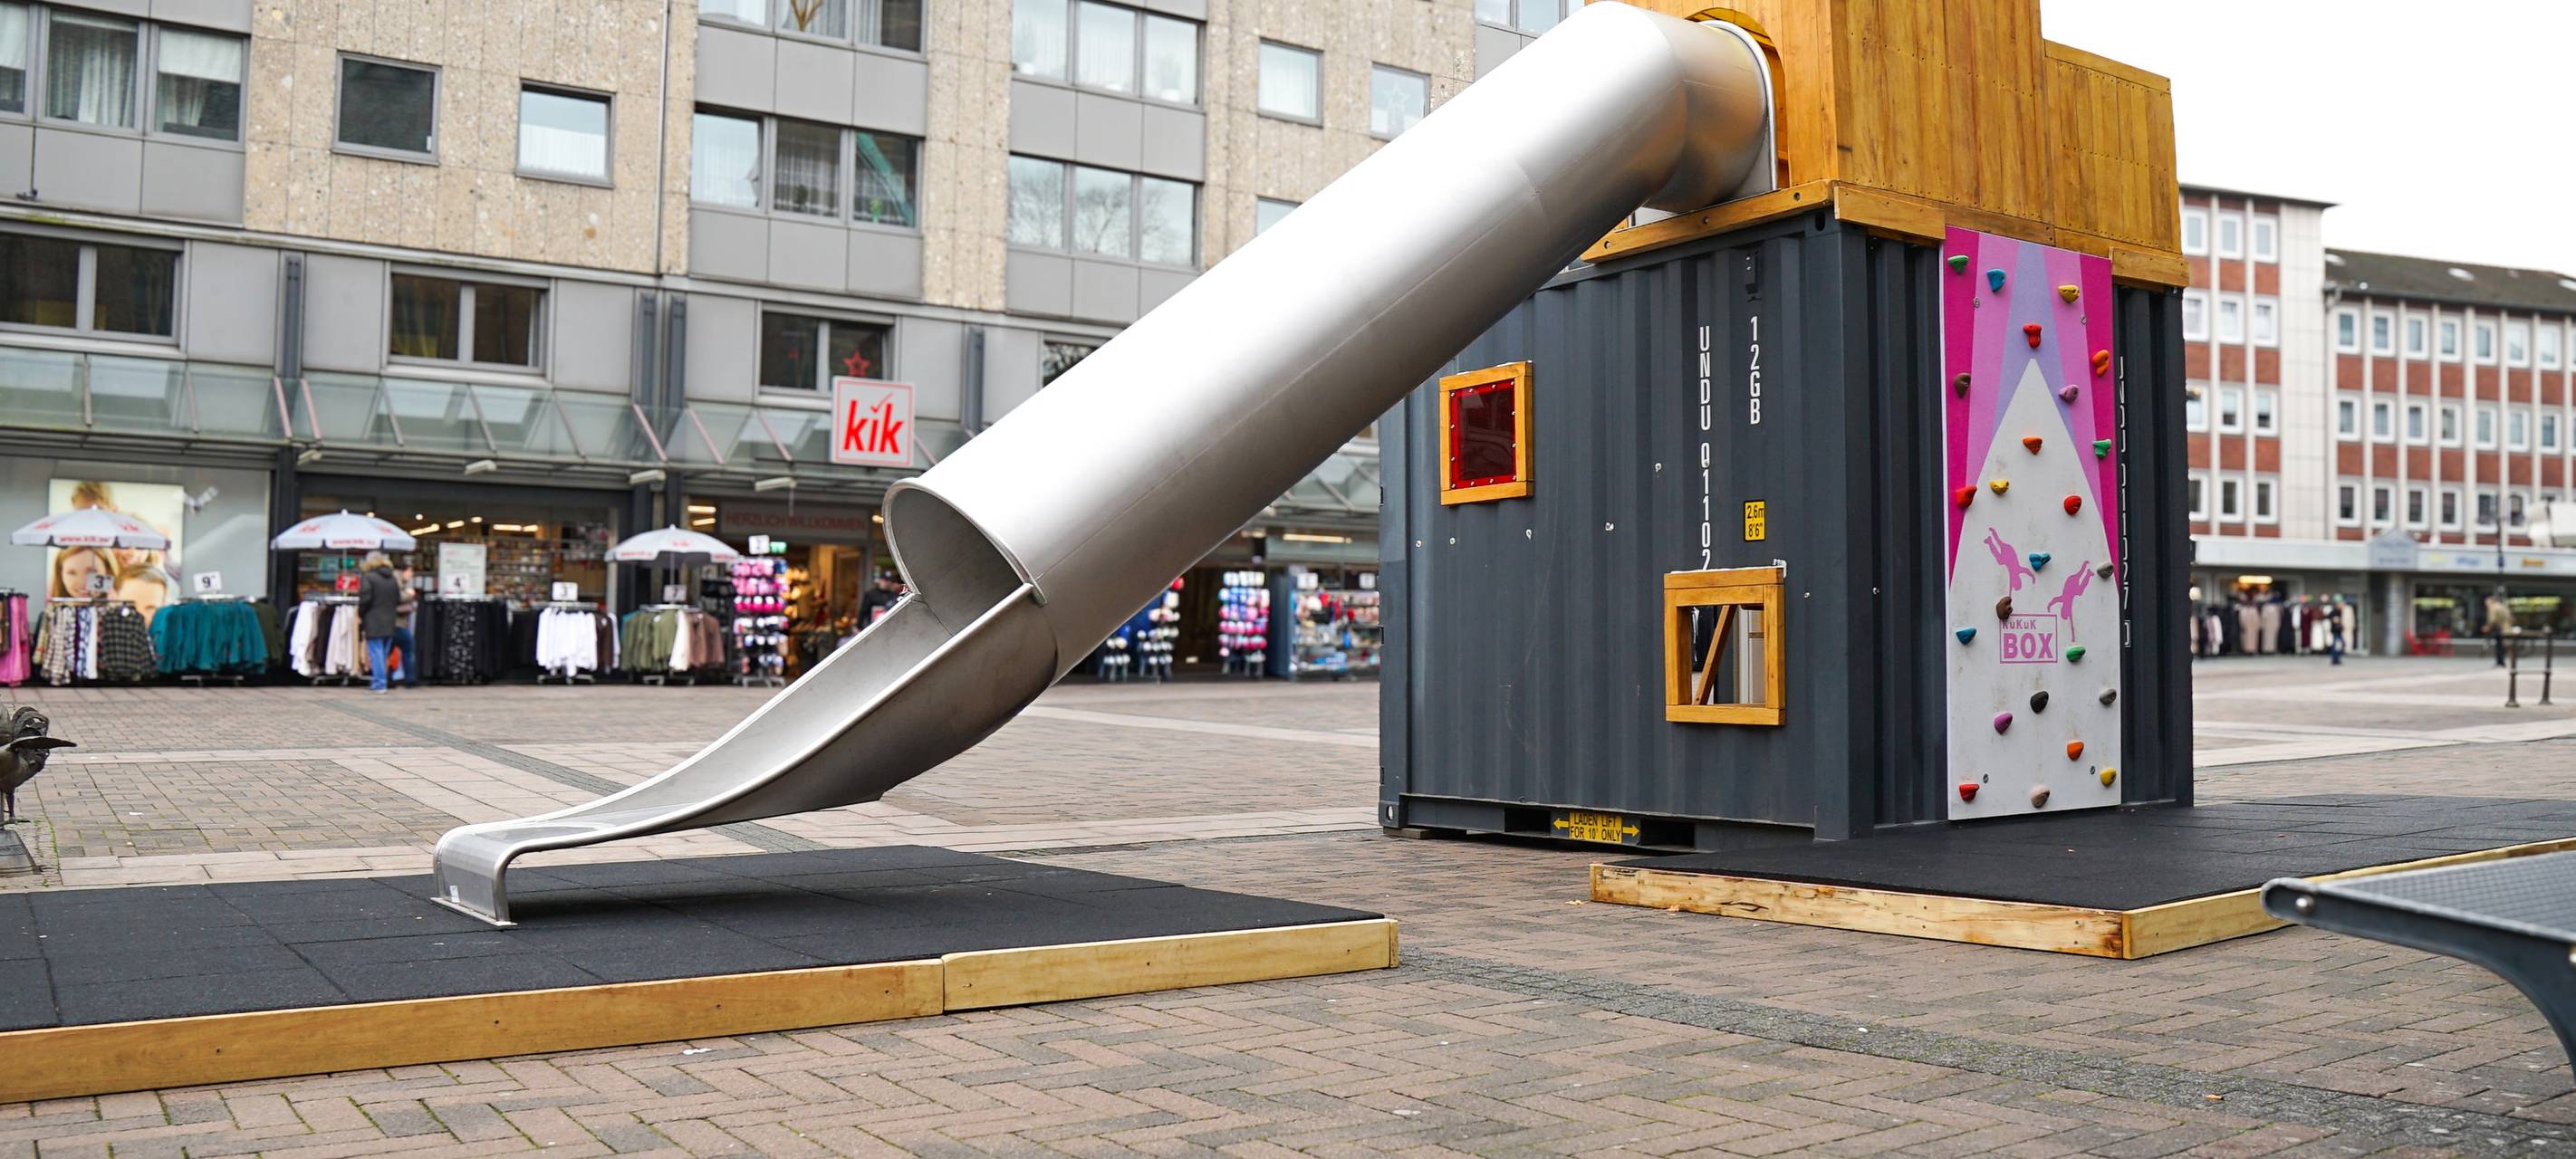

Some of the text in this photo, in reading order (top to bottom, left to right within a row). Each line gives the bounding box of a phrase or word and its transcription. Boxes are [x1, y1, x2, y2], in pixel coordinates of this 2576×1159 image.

[1699, 325, 1711, 431] UNDU
[1750, 316, 1761, 425] 12GB
[843, 393, 904, 454] kik
[2004, 633, 2053, 658] BOX
[1570, 826, 1585, 838] FOR
[1600, 829, 1621, 842] ONLY
[1574, 812, 1618, 828] LADEN LIFT
